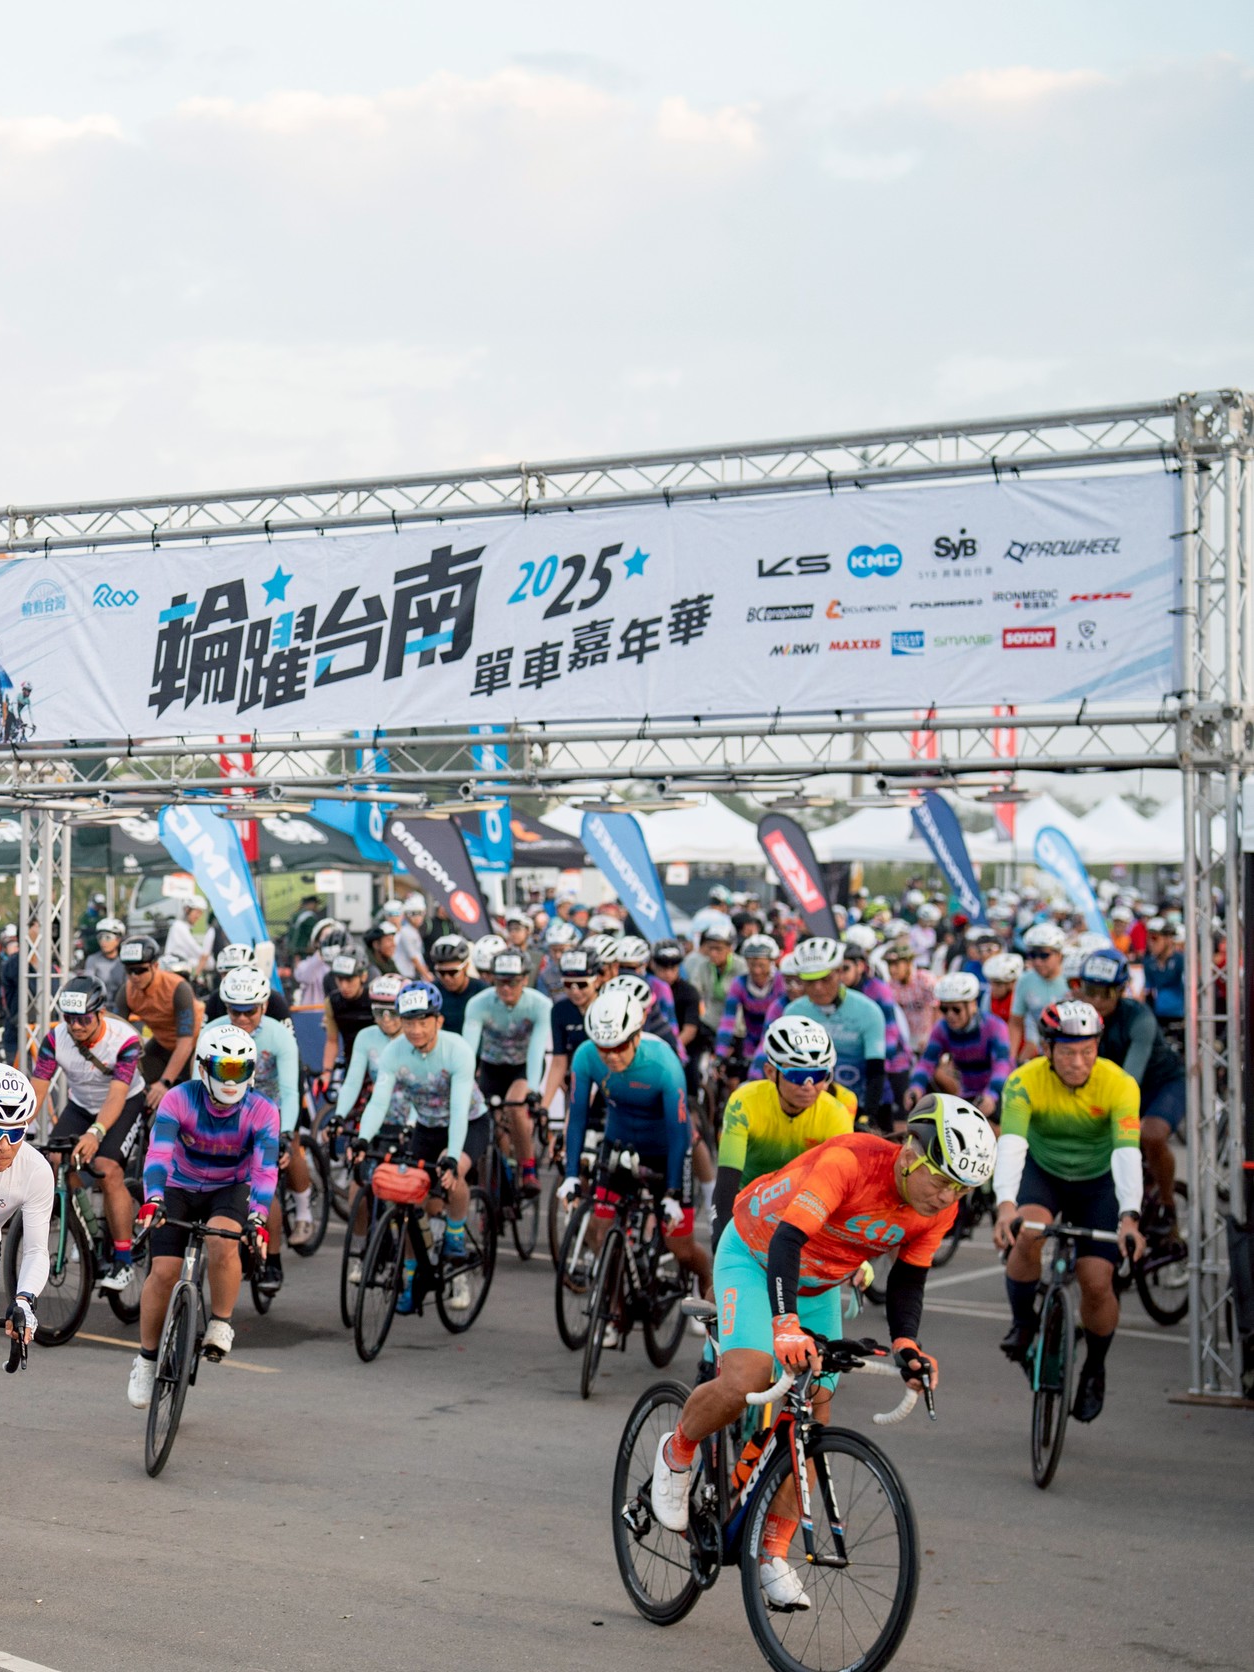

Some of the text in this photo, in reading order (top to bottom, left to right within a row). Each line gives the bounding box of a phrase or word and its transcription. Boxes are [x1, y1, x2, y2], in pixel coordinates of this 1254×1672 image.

[1024, 537, 1121, 558] PROWHEEL
[758, 553, 831, 578] KS
[850, 553, 899, 569] KMC
[507, 542, 624, 620] 2025
[148, 544, 487, 720] 輪躍台南
[1004, 630, 1054, 646] SOYJOY
[470, 594, 714, 697] 單車嘉年華
[829, 638, 881, 651] MAXXIS
[1065, 639, 1109, 650] ZALY
[231, 984, 253, 992] 0016
[61, 999, 83, 1008] 0893
[794, 1034, 825, 1045] 0143
